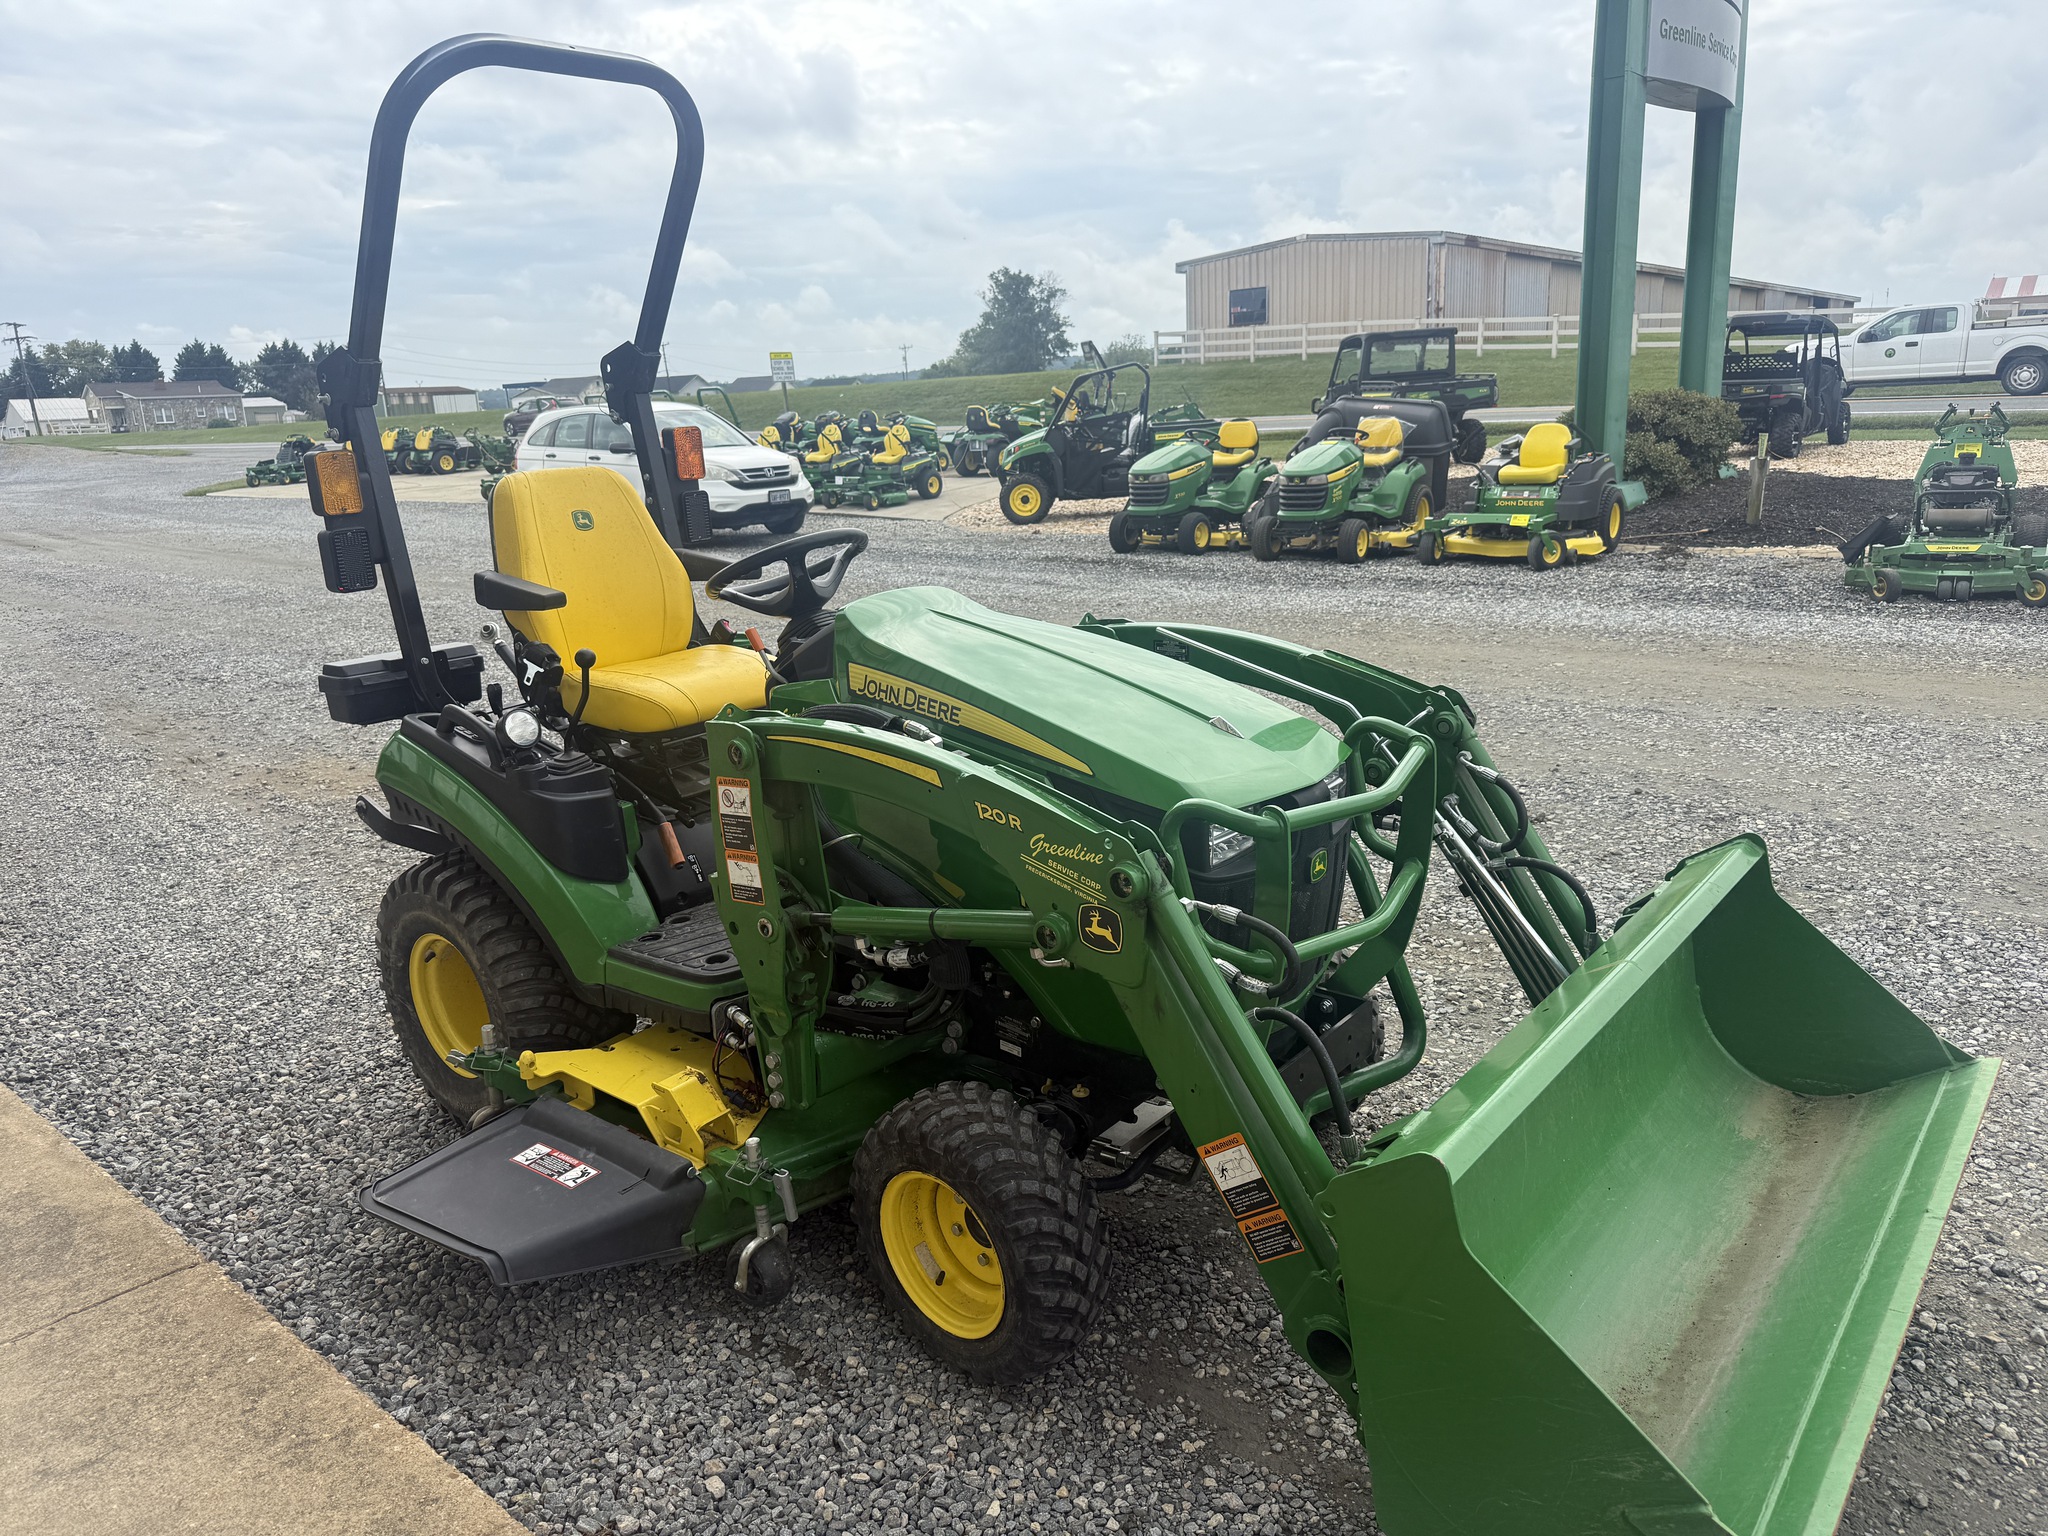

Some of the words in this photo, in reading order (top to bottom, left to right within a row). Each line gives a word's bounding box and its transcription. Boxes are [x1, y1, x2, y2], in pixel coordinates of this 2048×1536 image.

[1659, 18, 1707, 49] Greenline
[1708, 32, 1729, 61] Service
[1495, 499, 1517, 507] JOHN
[1517, 499, 1545, 507] DEERE
[857, 674, 901, 706] JOHN
[902, 687, 962, 725] DEERE
[722, 778, 749, 788] WARNING
[731, 852, 757, 863] WARNING
[1029, 833, 1104, 865] Greenline
[1025, 864, 1073, 893] FREDERICKSBURG,
[1073, 889, 1098, 906] VIRGINIA
[1047, 859, 1079, 880] SERVICE
[1080, 876, 1102, 892] CORP.
[1209, 1137, 1240, 1153] WARNING
[1251, 1213, 1282, 1228] WARNING
